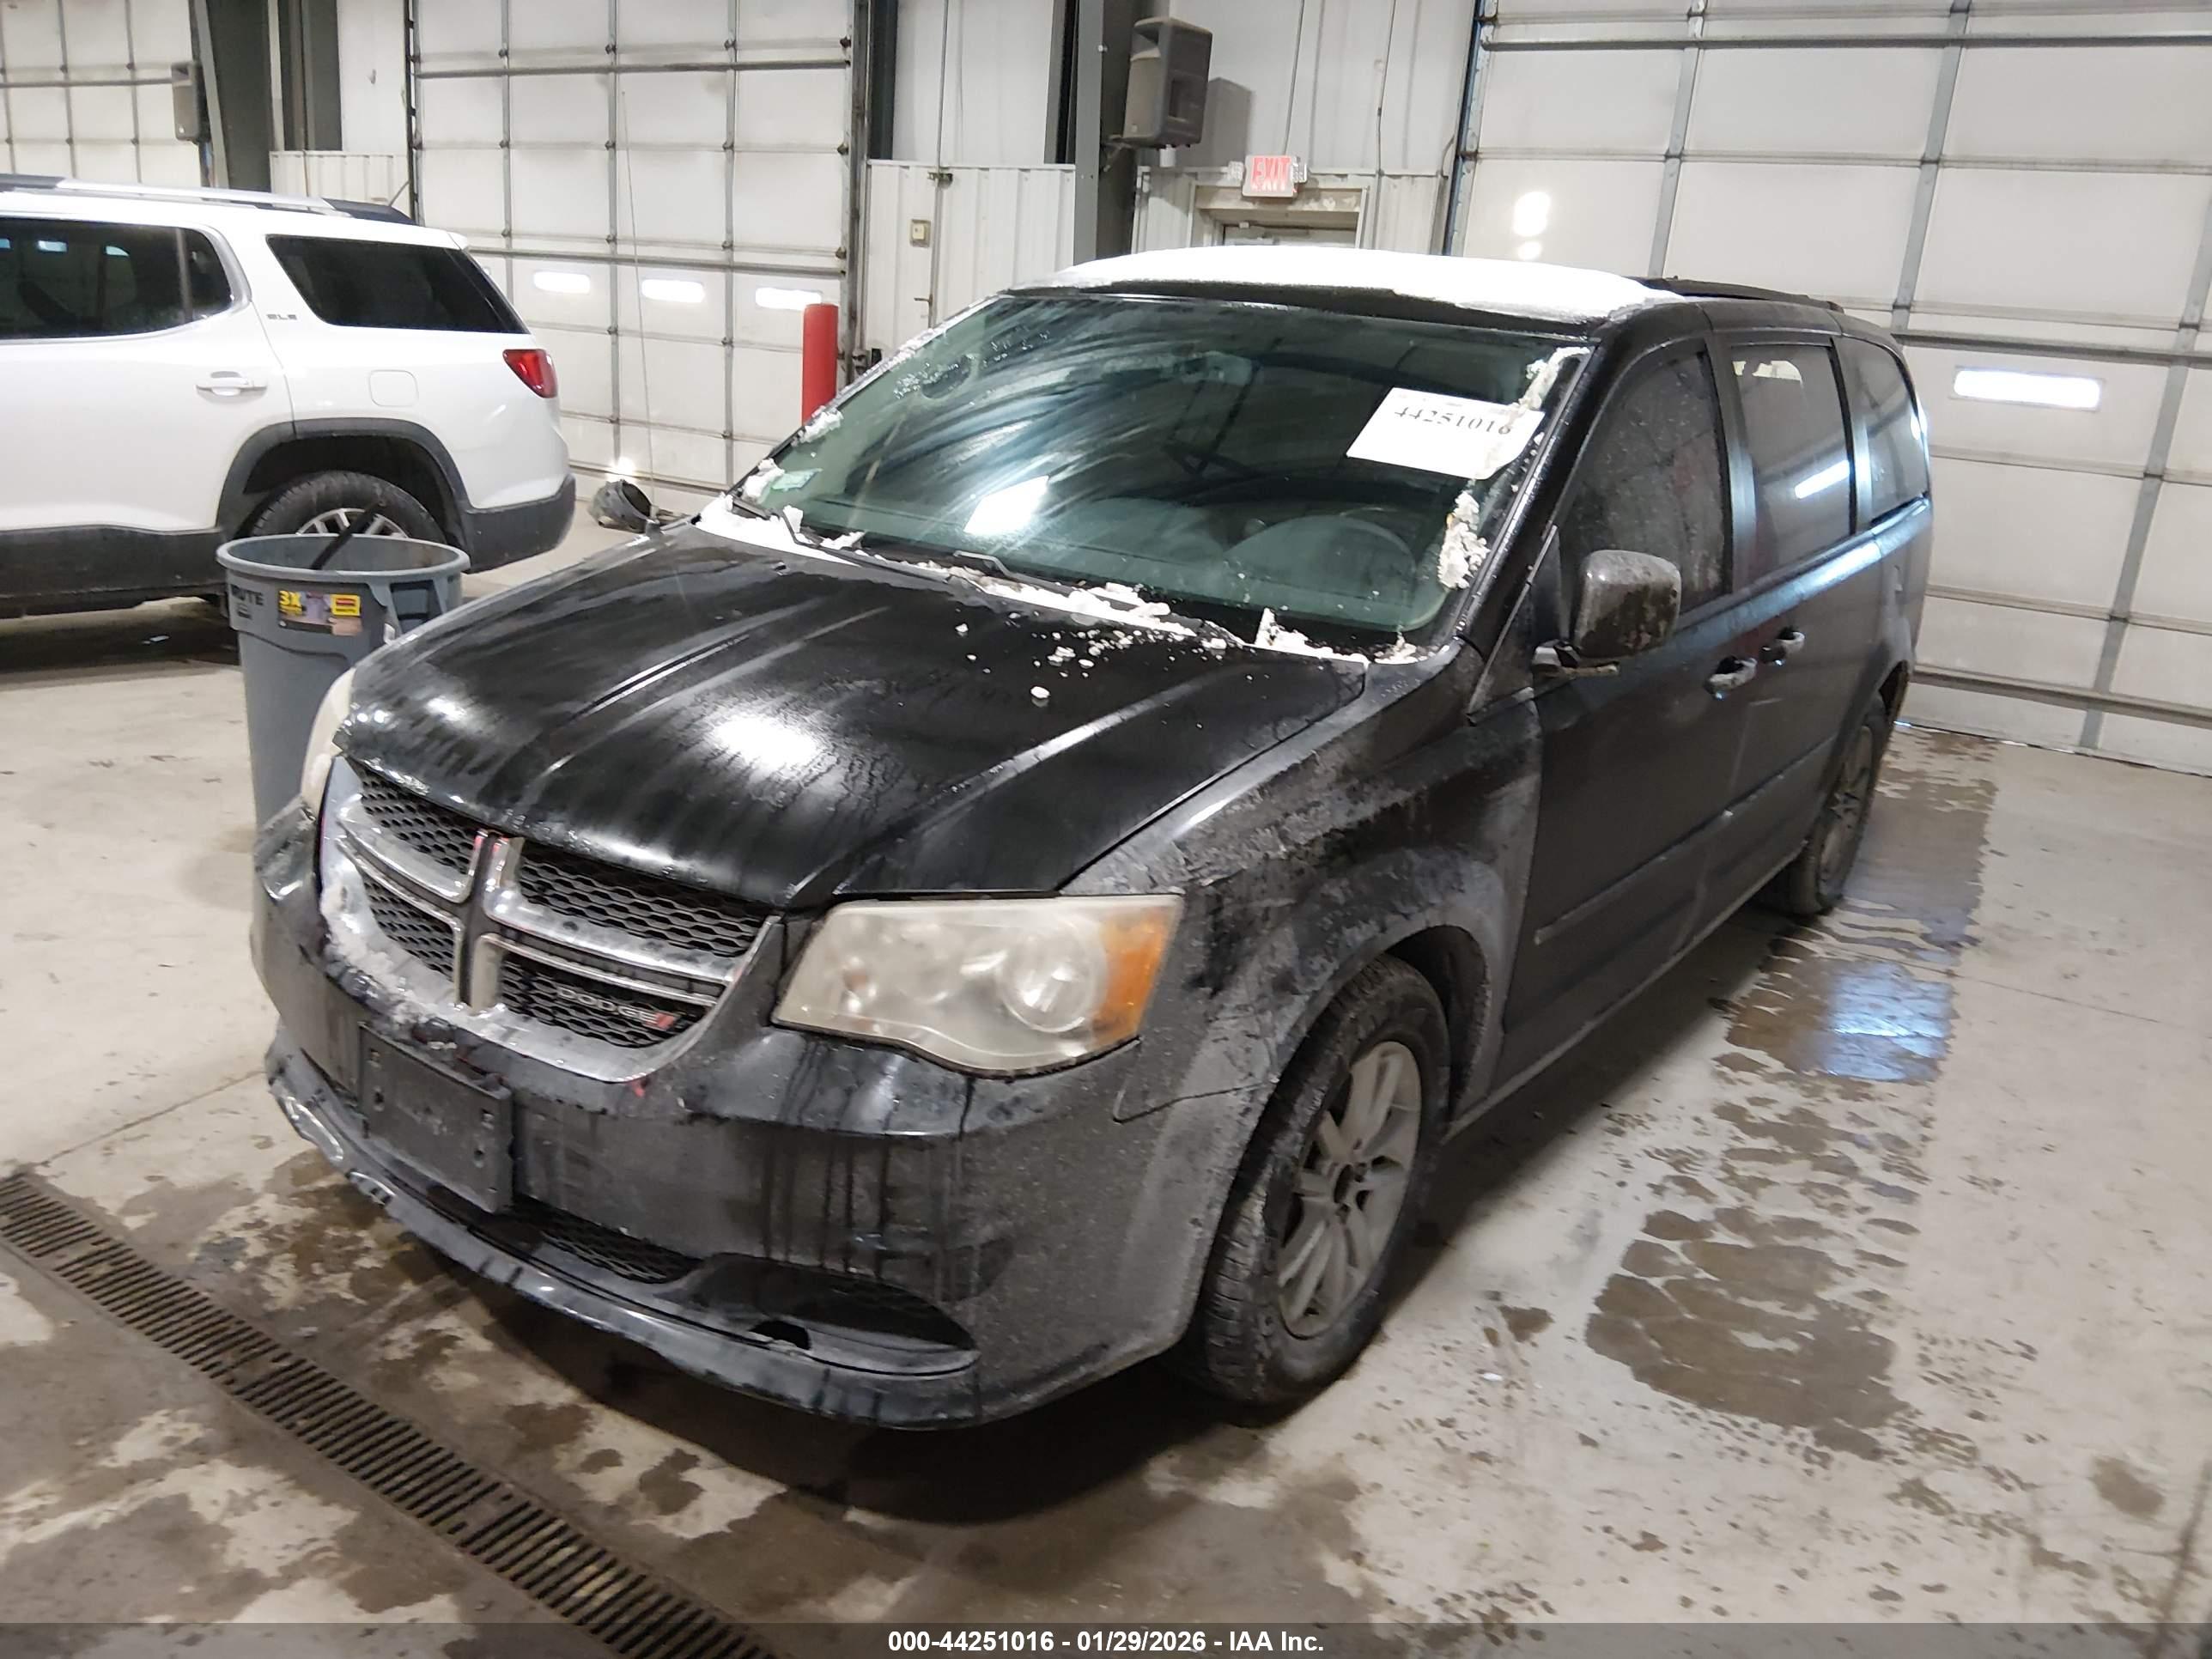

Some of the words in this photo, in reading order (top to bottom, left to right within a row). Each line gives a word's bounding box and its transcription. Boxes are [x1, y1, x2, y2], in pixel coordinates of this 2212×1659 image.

[1250, 156, 1291, 191] EXIT
[1394, 406, 1511, 435] 44251016
[557, 987, 658, 1026] DODGE
